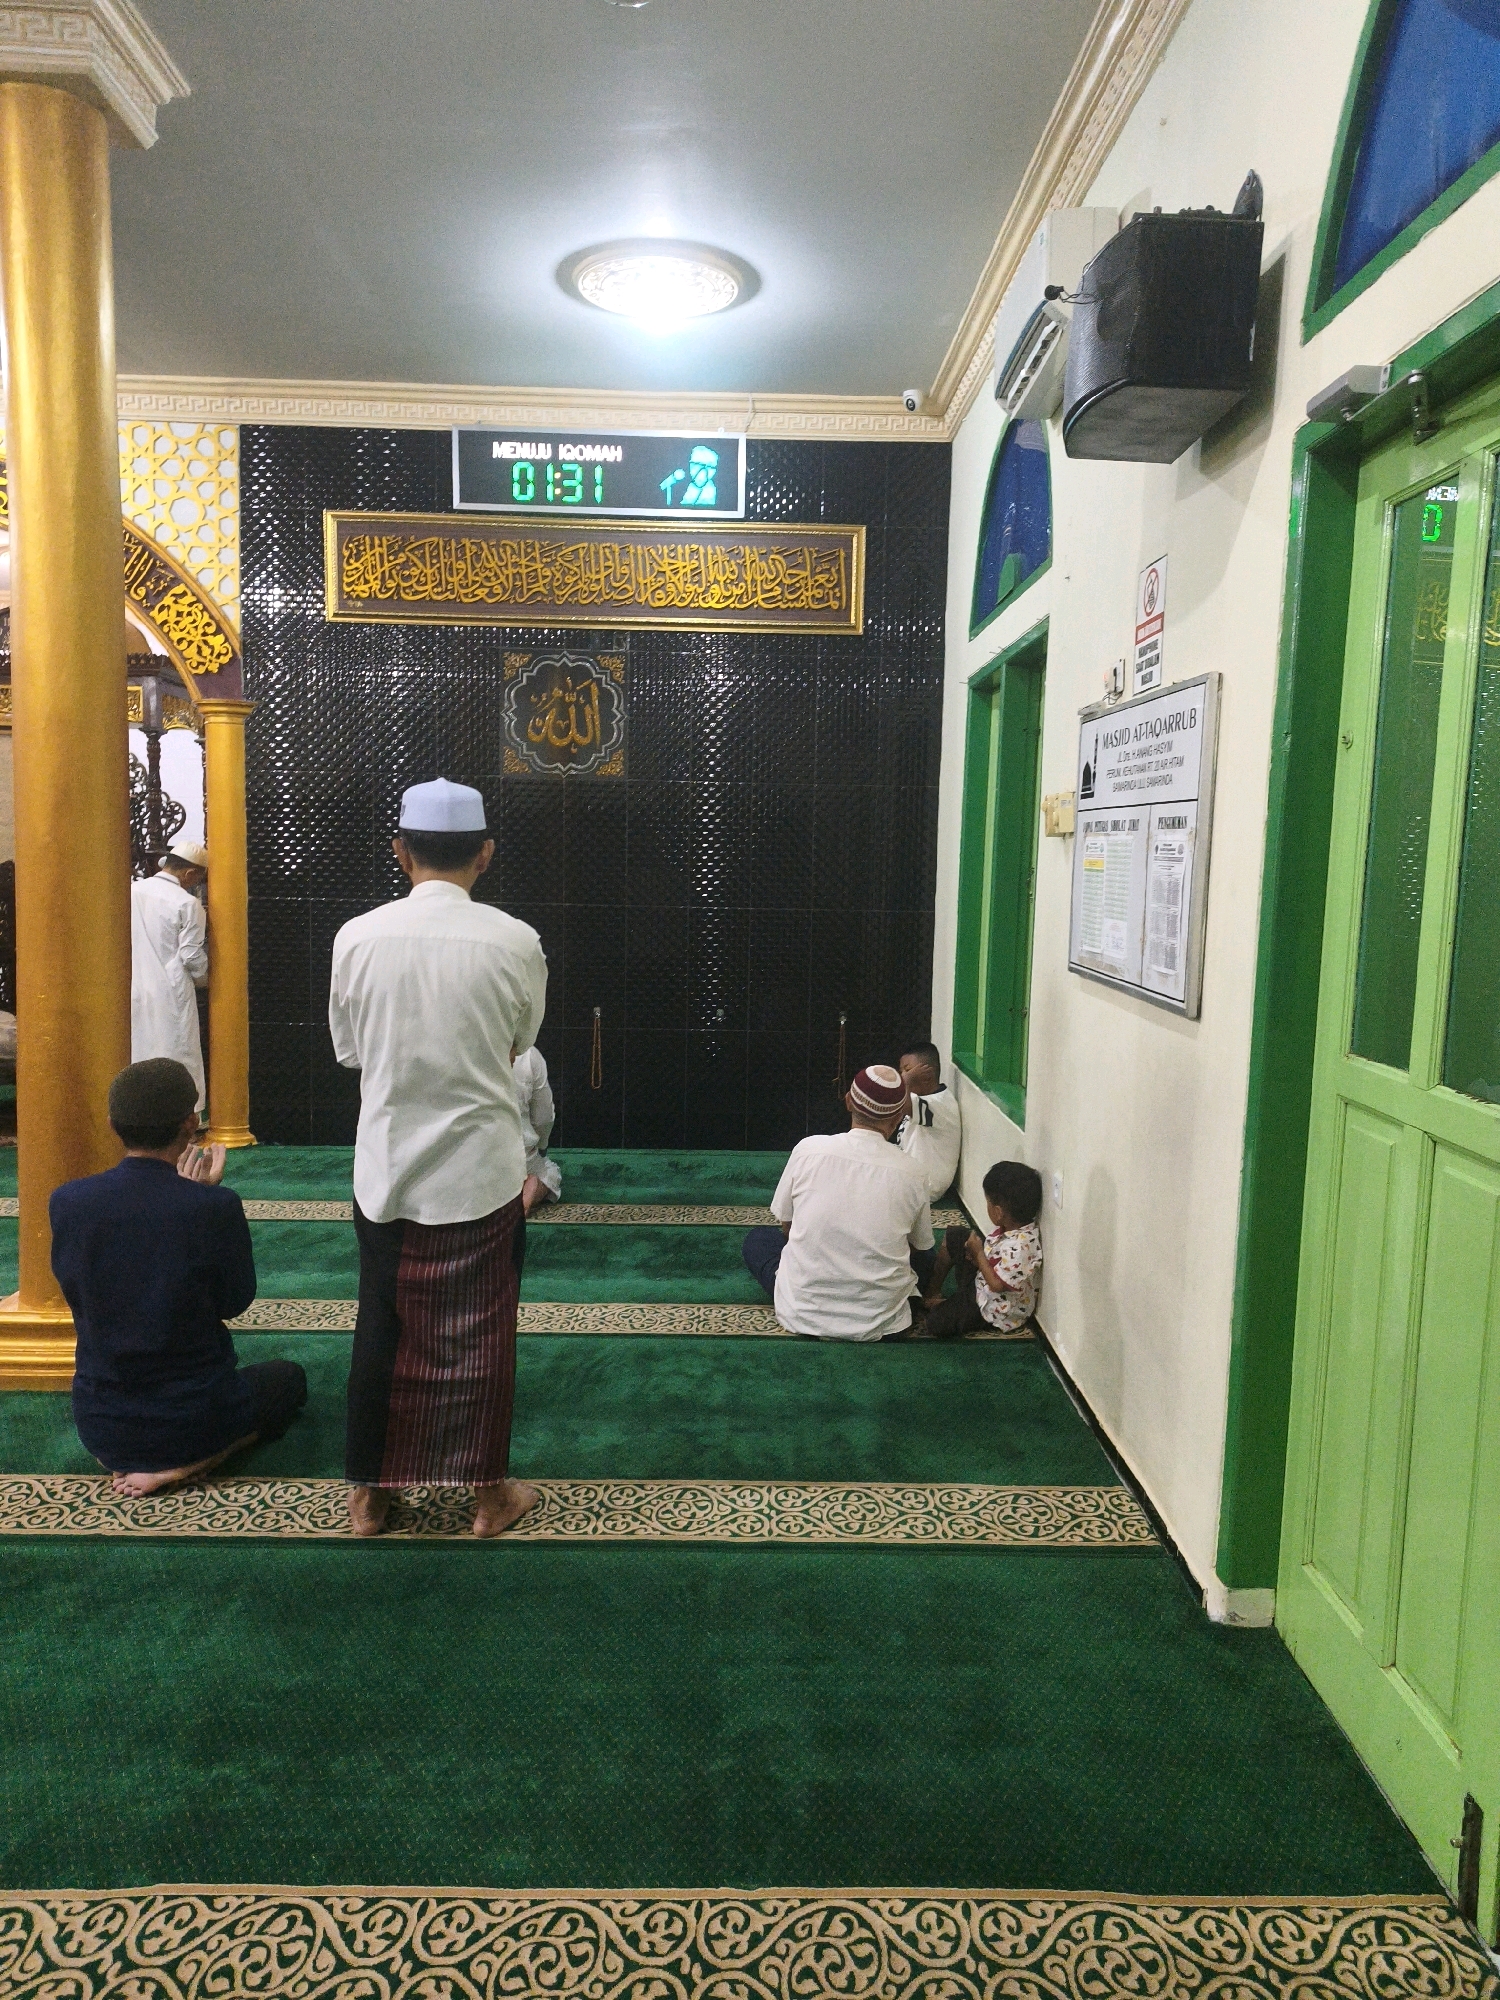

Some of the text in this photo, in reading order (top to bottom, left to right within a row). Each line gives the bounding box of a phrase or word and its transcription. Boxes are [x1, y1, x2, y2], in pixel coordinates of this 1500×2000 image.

[492, 441, 623, 462] MENUJU IQOMAH
[511, 461, 604, 504] 01:31
[527, 677, 601, 754] الله
[1101, 707, 1197, 750] MASJID AT-TAQARRUB
